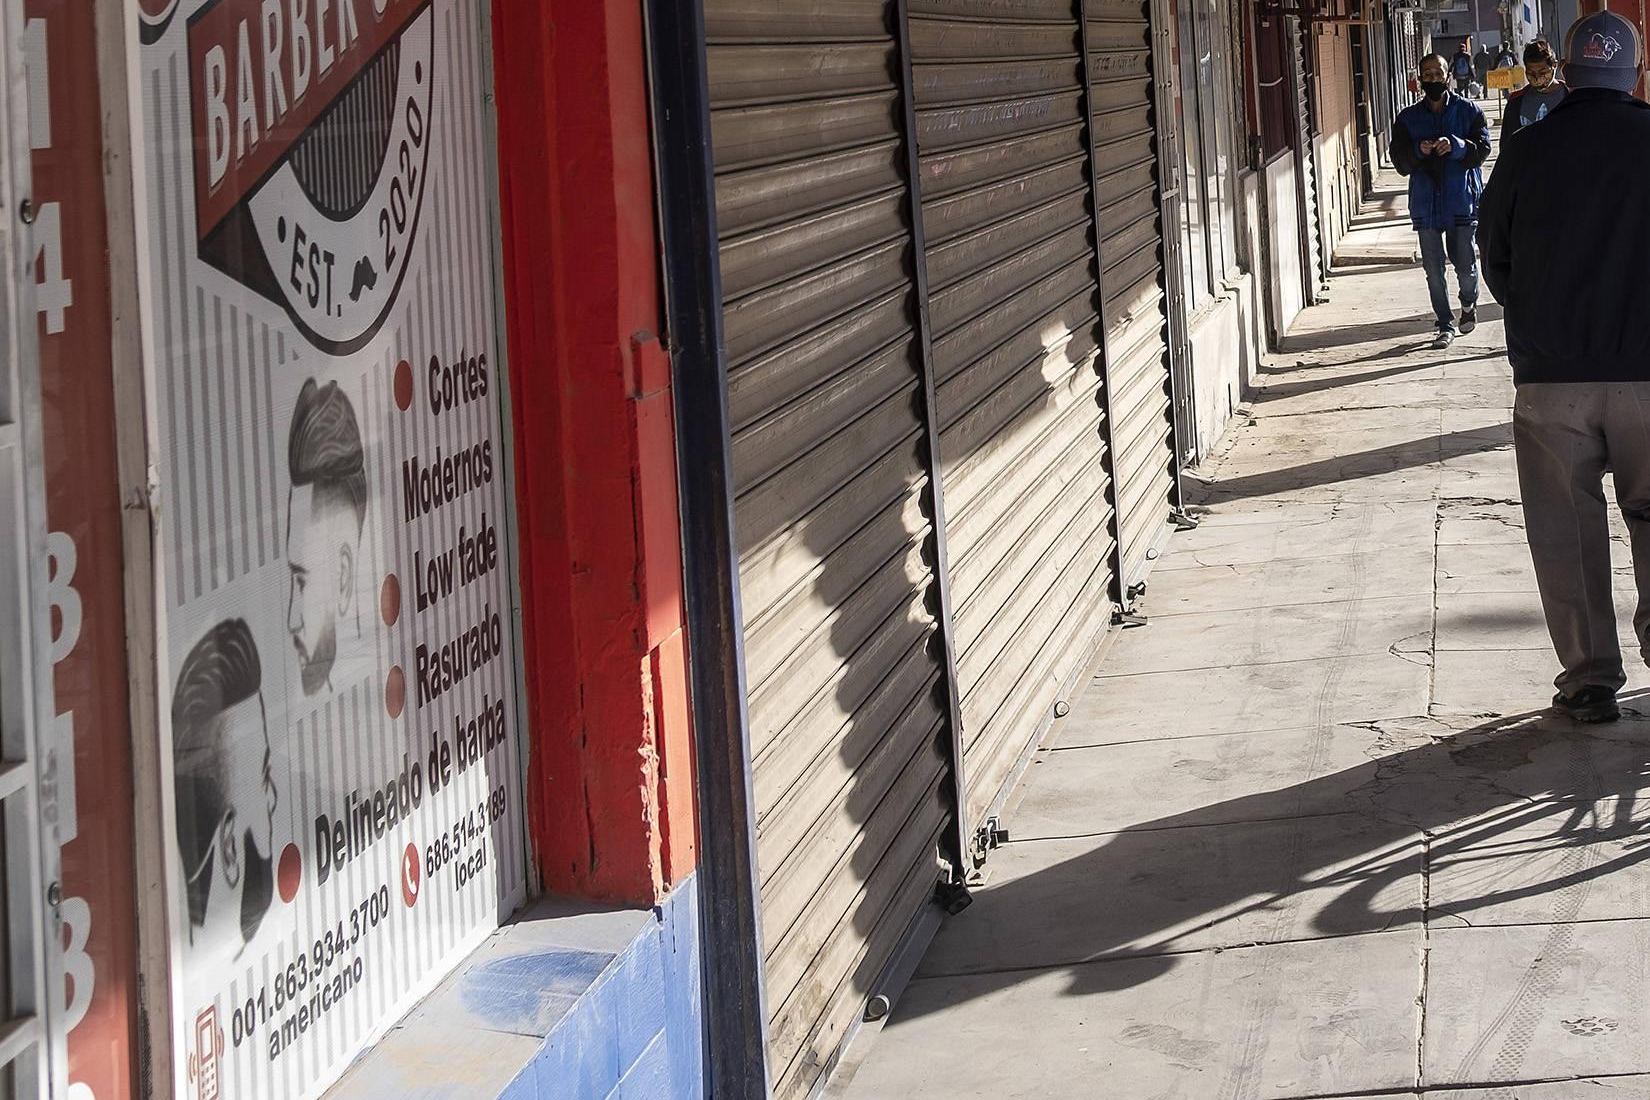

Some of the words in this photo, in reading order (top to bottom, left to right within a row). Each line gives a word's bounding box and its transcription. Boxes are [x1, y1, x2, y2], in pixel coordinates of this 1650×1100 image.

[290, 222, 342, 318] EST.
[379, 95, 423, 273] 2020
[428, 349, 488, 416] Cortes
[402, 438, 493, 523] Modernos
[414, 545, 454, 613] Low
[459, 512, 497, 590] fade
[415, 603, 501, 709] Rasurado
[315, 752, 422, 886] Delineado
[428, 730, 451, 797] de
[455, 694, 506, 776] barba
[426, 785, 506, 878] 686.514.3189
[455, 837, 487, 892] local
[232, 883, 389, 1048] 001.863.934.3700
[269, 956, 362, 1061] americano
